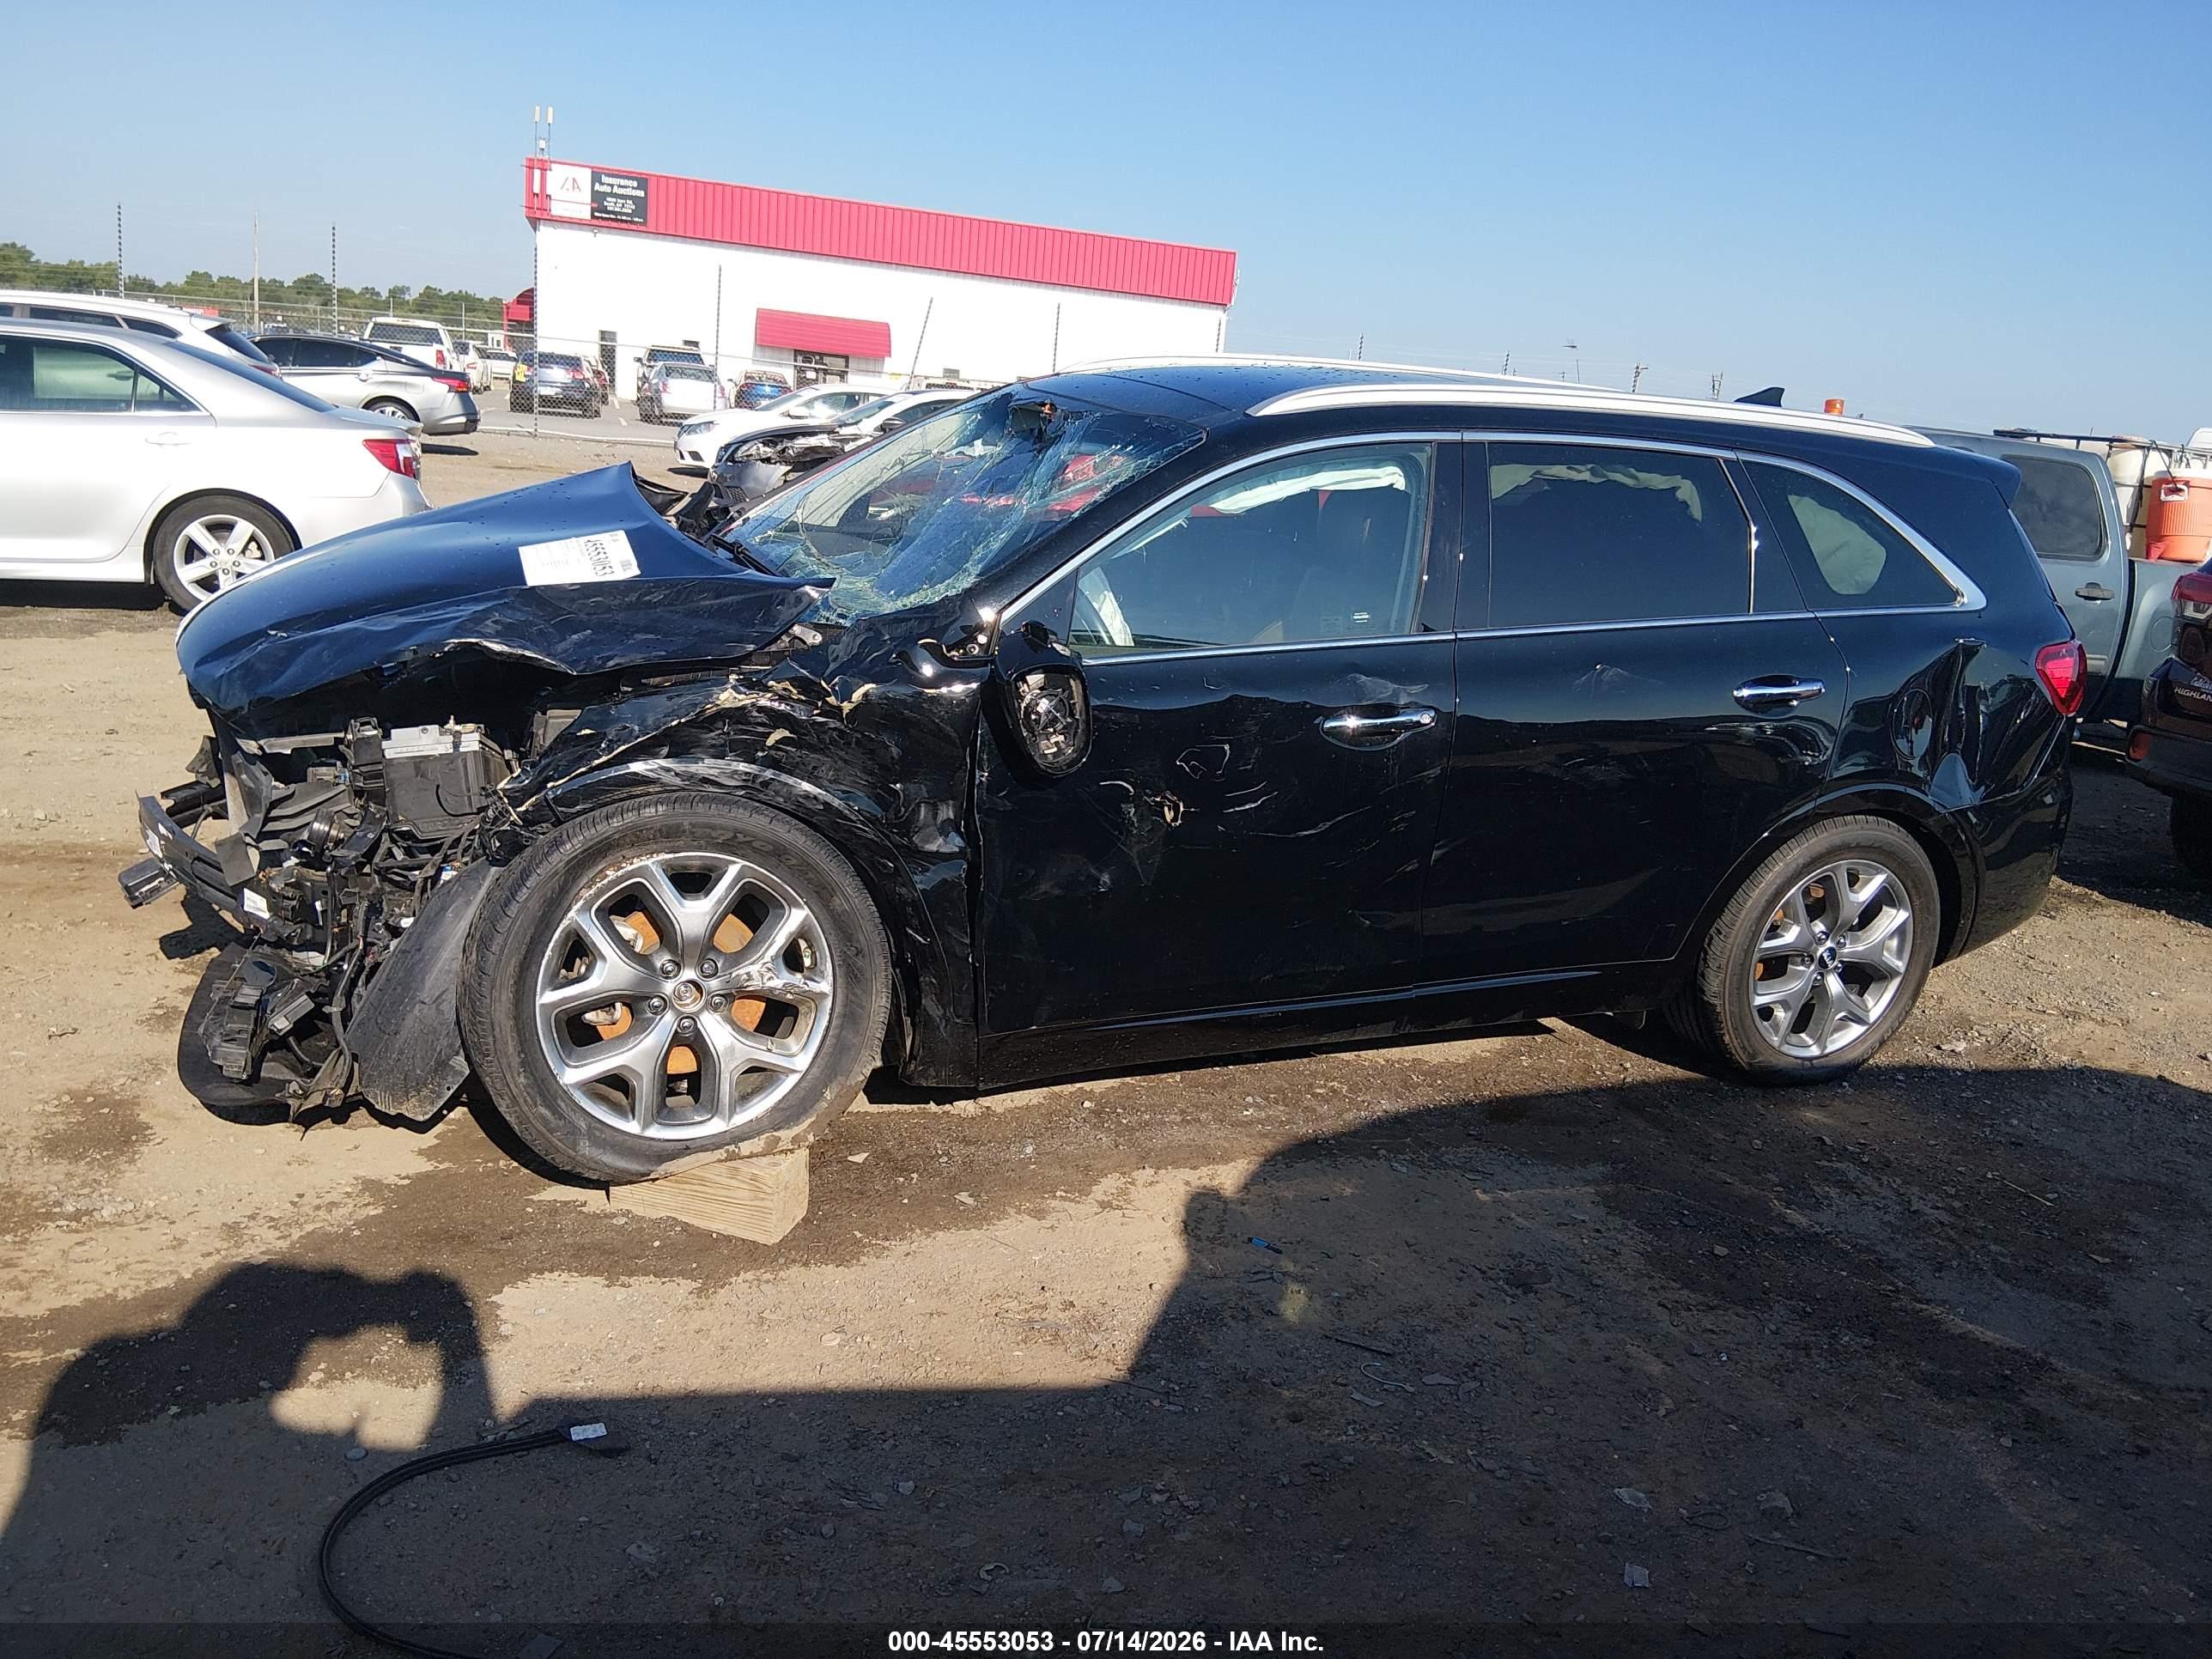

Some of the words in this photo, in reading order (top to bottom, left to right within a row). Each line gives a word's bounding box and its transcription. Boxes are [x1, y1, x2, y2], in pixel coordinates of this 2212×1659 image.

[601, 174, 638, 188] Insurance
[594, 182, 611, 193] Auto
[612, 185, 645, 198] Auctions
